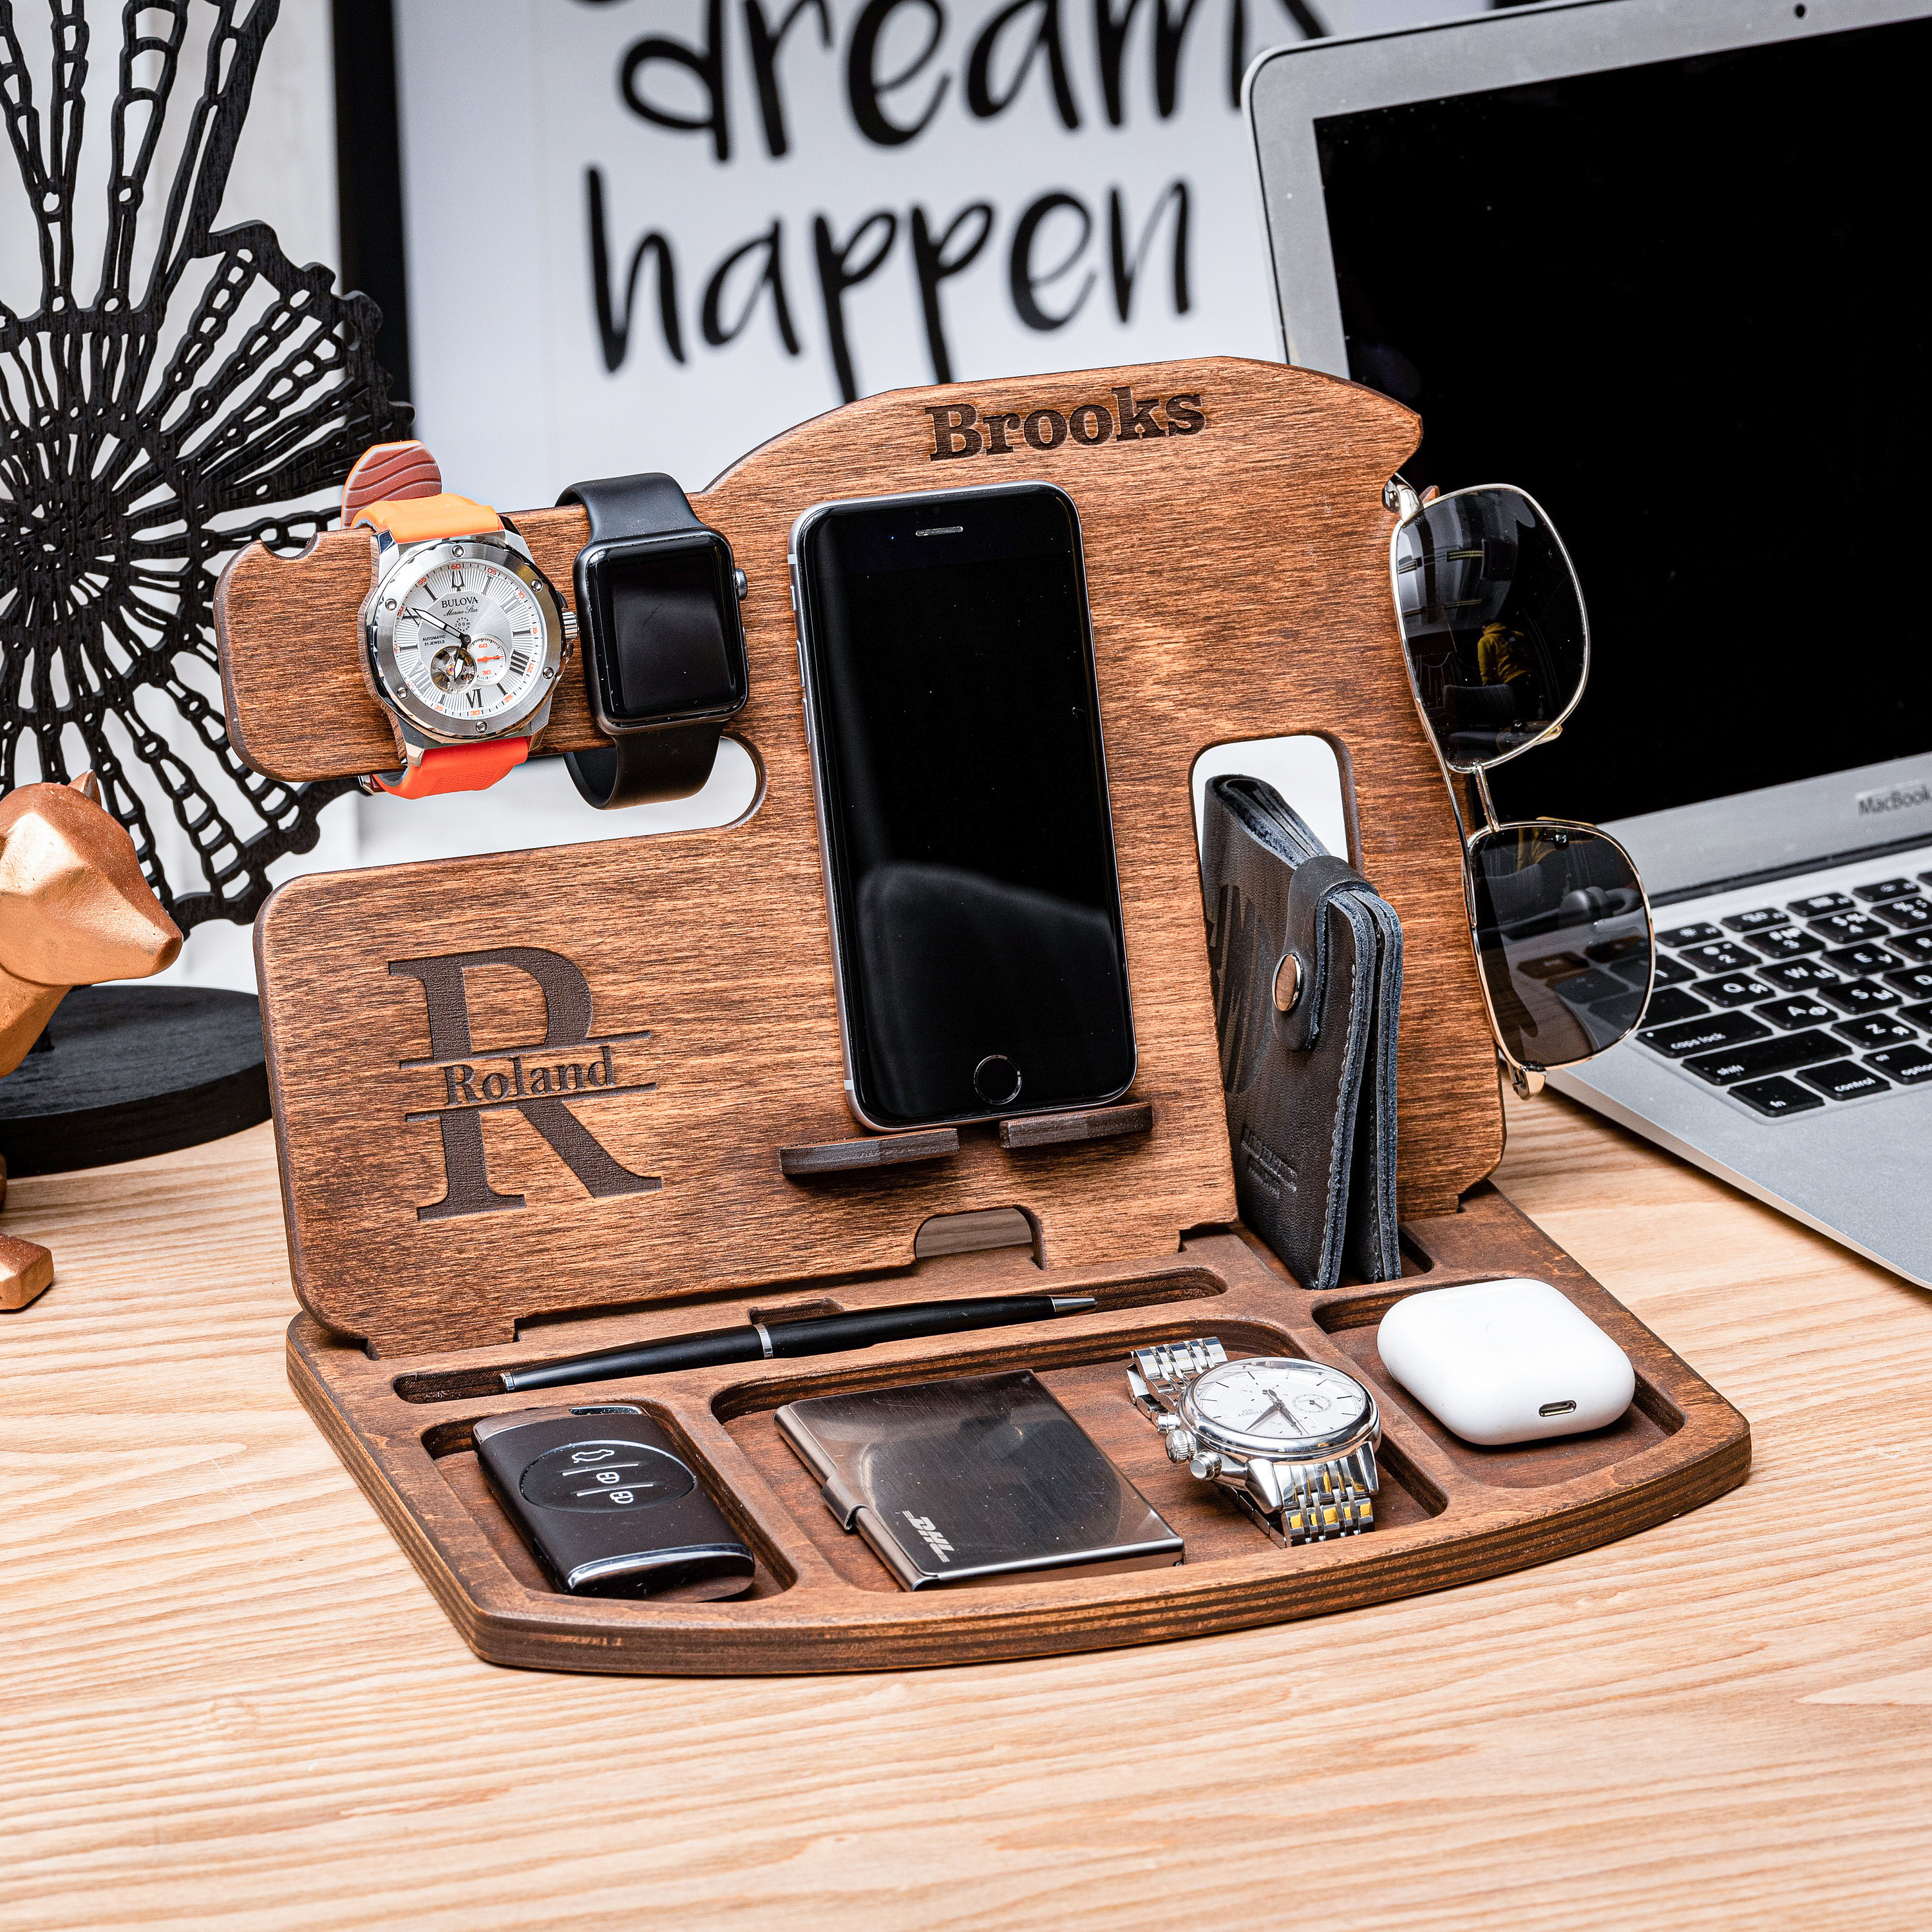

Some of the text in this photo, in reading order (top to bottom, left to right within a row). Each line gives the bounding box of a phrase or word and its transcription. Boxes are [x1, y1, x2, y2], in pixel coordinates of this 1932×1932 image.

[584, 164, 1197, 404] happen
[925, 386, 1208, 462] Brooks
[441, 596, 478, 609] BULOVA
[443, 605, 478, 616] Marine Star
[1723, 983, 1746, 993] Q
[1851, 989, 1870, 999] S
[1787, 1006, 1807, 1017] A
[1865, 1023, 1887, 1035] Z
[1671, 1032, 1727, 1050] caps lock
[443, 1046, 616, 1106] Roland
[1717, 1065, 1745, 1075] shift
[1834, 1077, 1876, 1092] control
